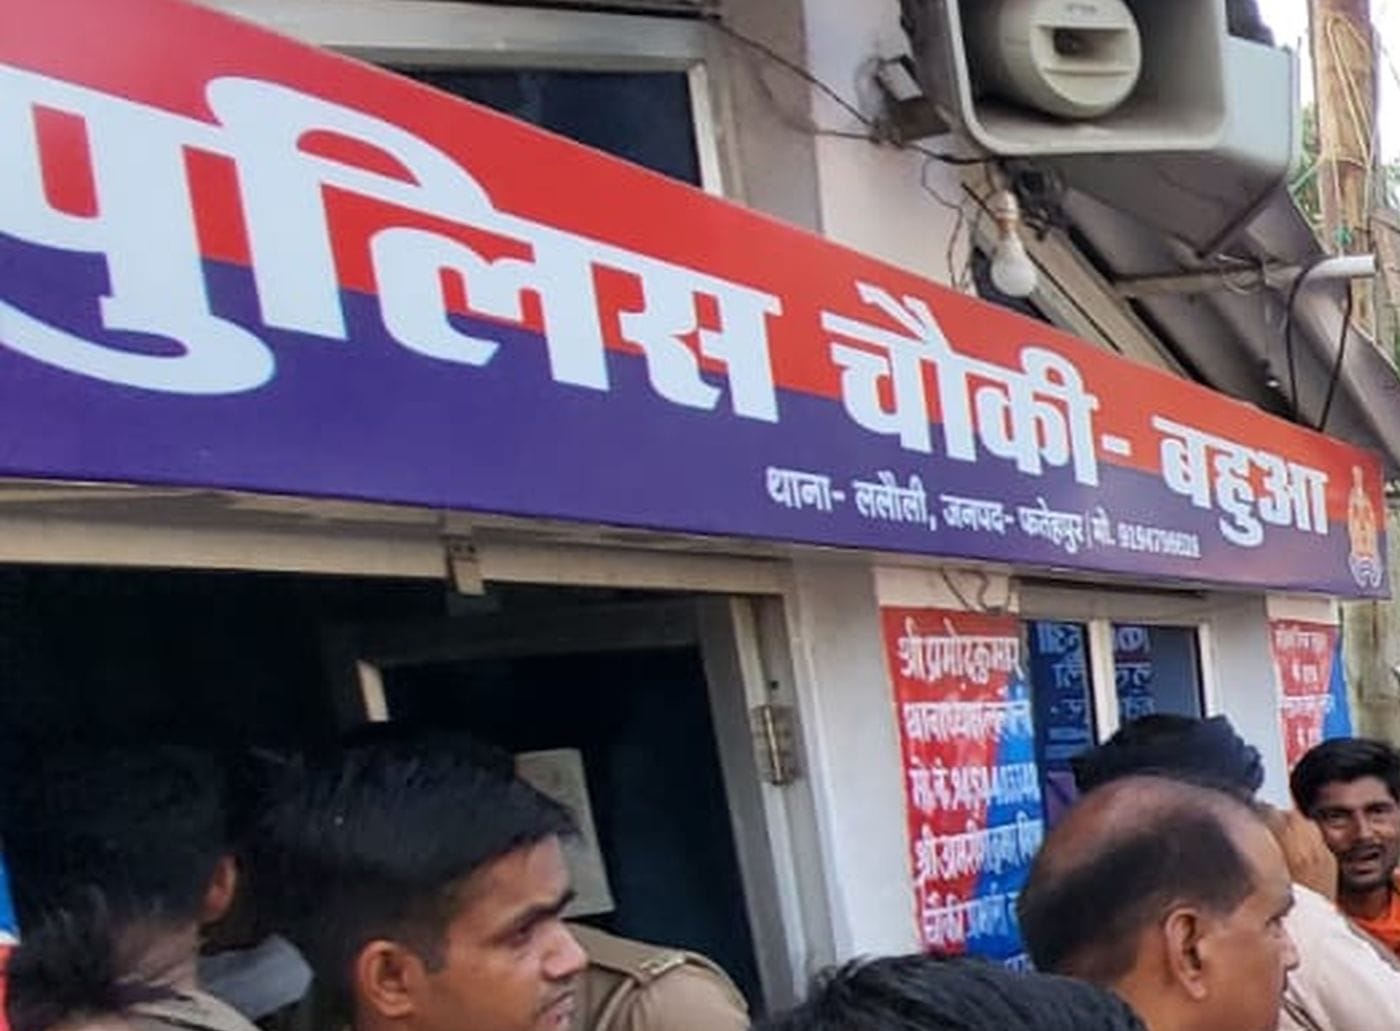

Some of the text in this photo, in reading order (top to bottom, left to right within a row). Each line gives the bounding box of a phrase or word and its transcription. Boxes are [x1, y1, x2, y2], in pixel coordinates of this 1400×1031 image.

[0, 62, 1329, 546] पुलिस चौकी- बहुआ
